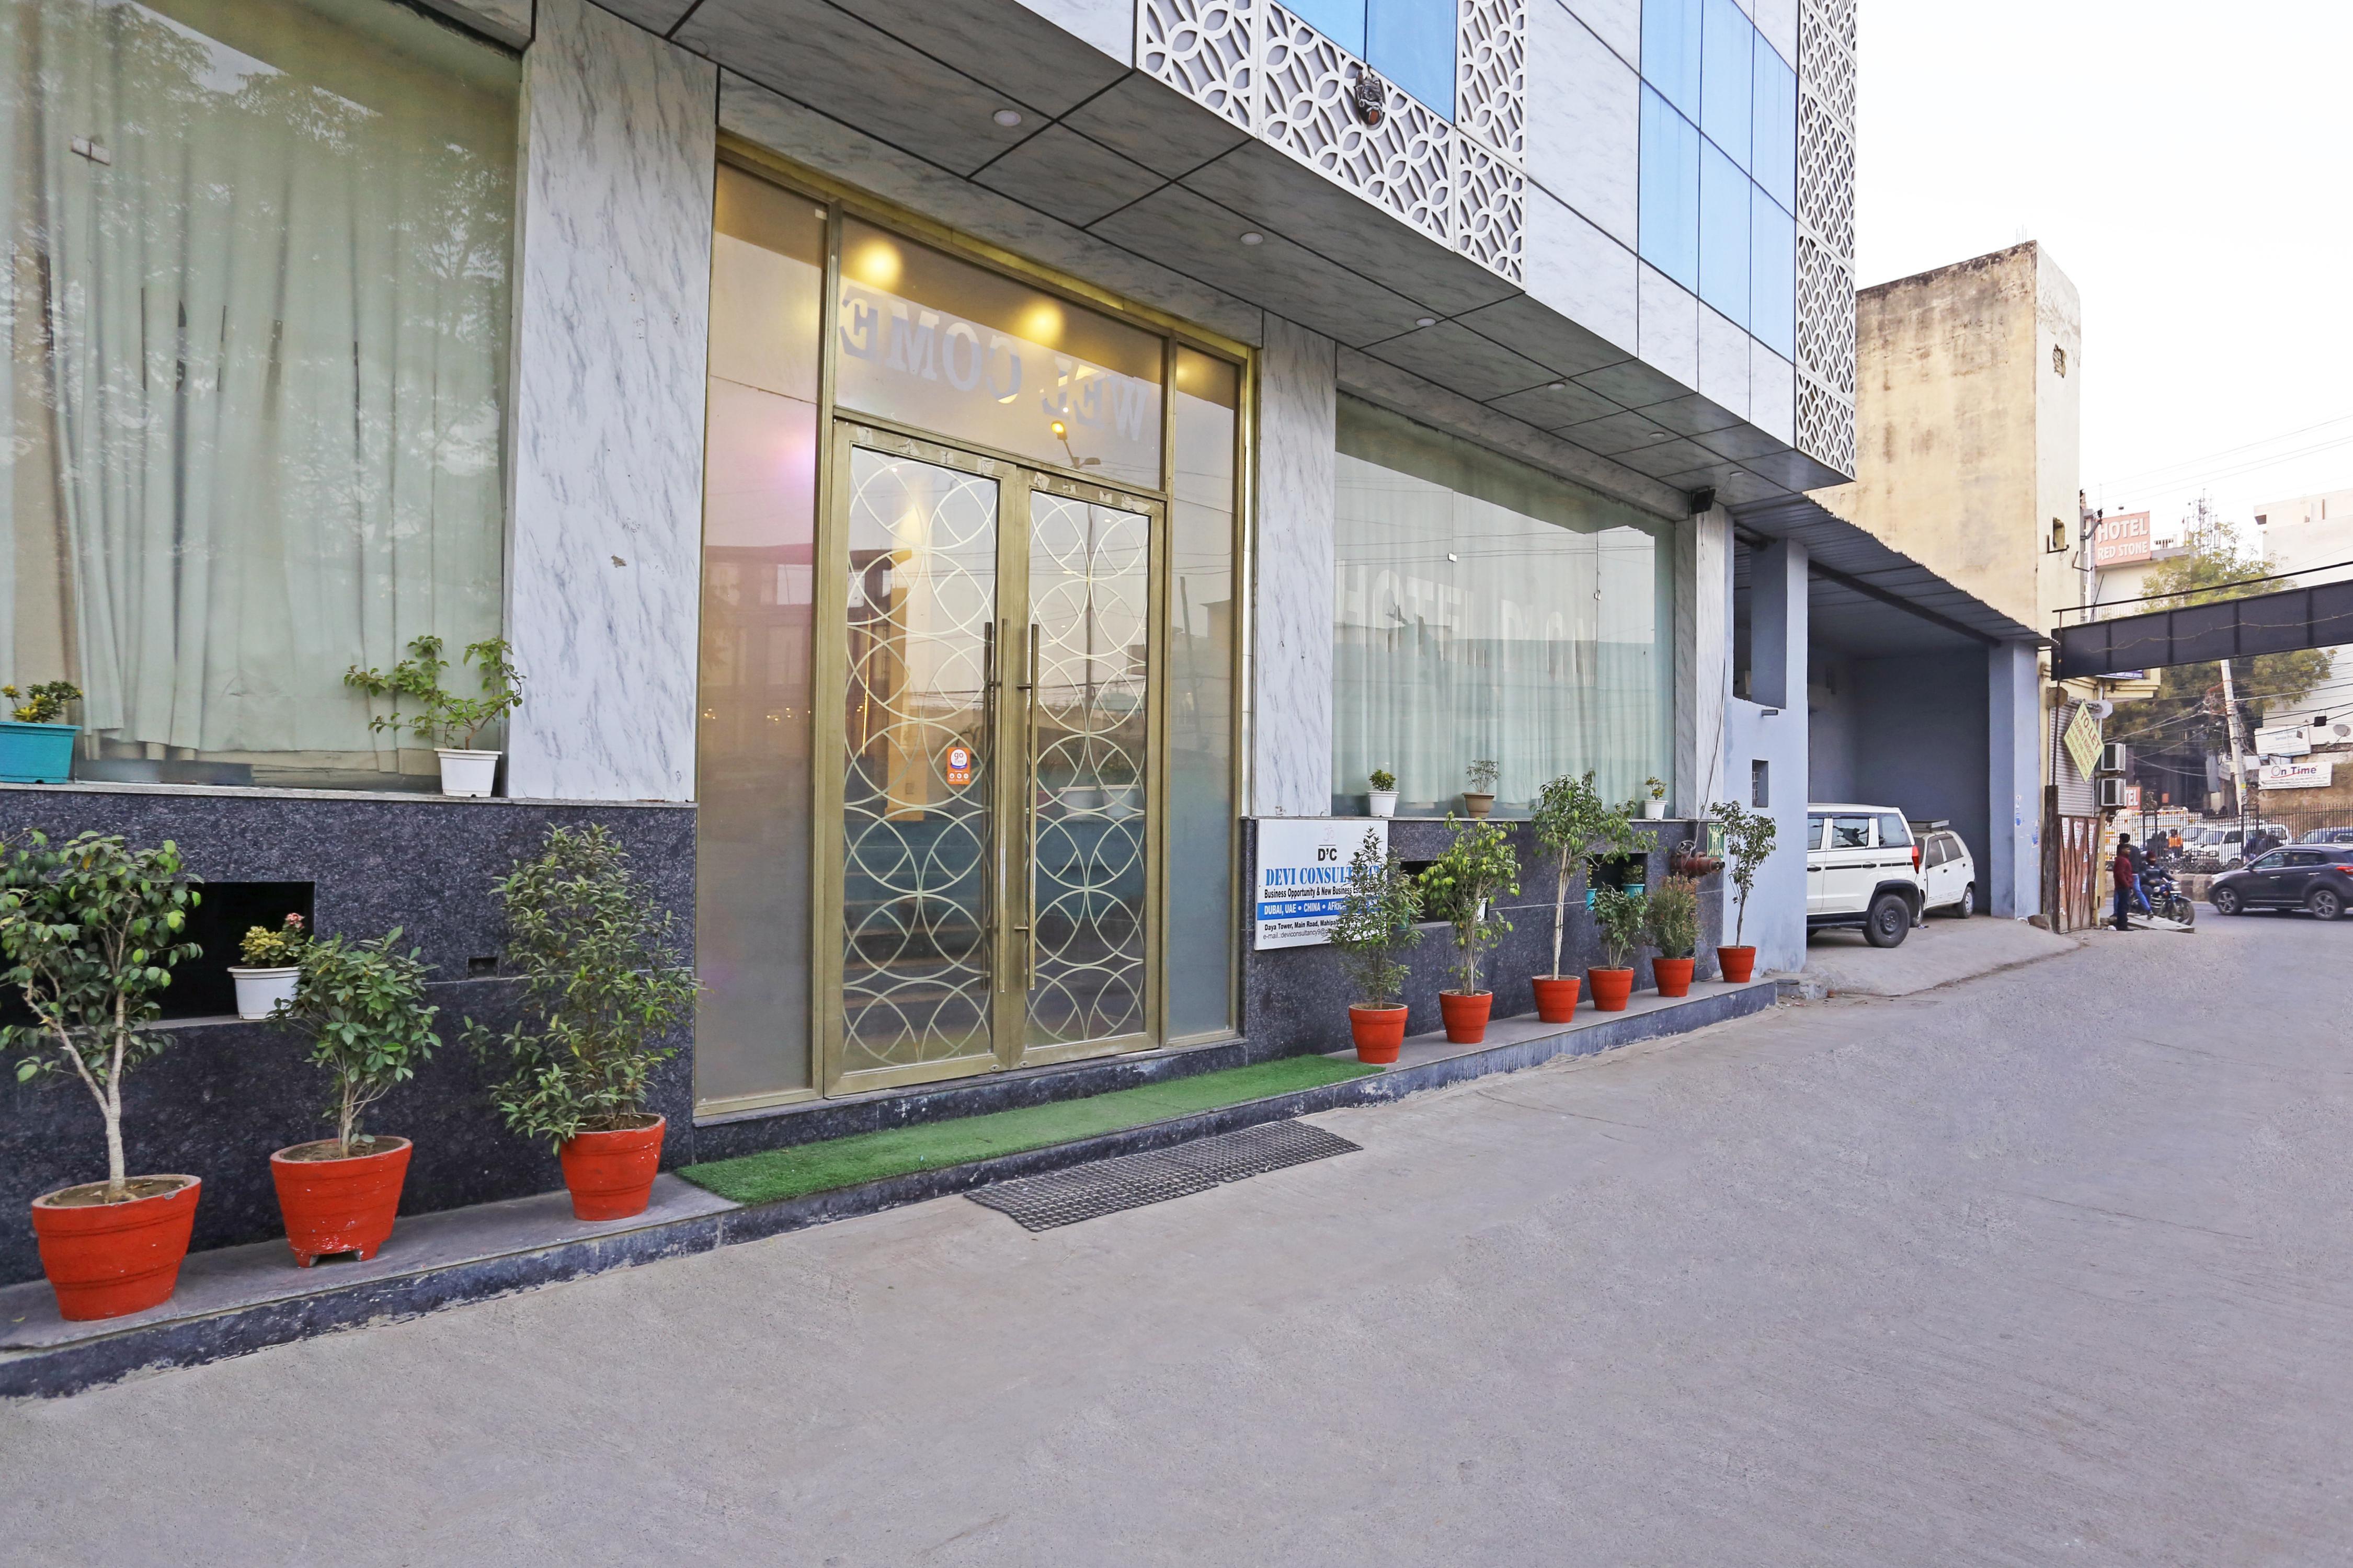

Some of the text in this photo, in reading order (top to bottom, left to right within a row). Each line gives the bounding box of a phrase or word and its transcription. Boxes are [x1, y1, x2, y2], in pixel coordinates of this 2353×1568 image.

[2098, 518, 2149, 544] HOTEL
[2098, 541, 2148, 560] RED STONE
[1334, 558, 1485, 669] HOTEL
[2081, 709, 2100, 751] TO-LET
[2271, 765, 2287, 776] On
[2291, 766, 2317, 774] Time
[2124, 789, 2139, 807] TEL
[1266, 868, 1296, 886] DEVI
[1264, 889, 1286, 898] Business
[1287, 887, 1316, 899] Opportunity
[1317, 887, 1320, 896] &
[1321, 886, 1332, 896] New
[1332, 886, 1352, 895] Business
[1264, 904, 1284, 916] DUBAI,
[1285, 903, 1296, 914] UAE
[1304, 902, 1321, 912] CHINA
[1320, 918, 1342, 927] Mahipal
